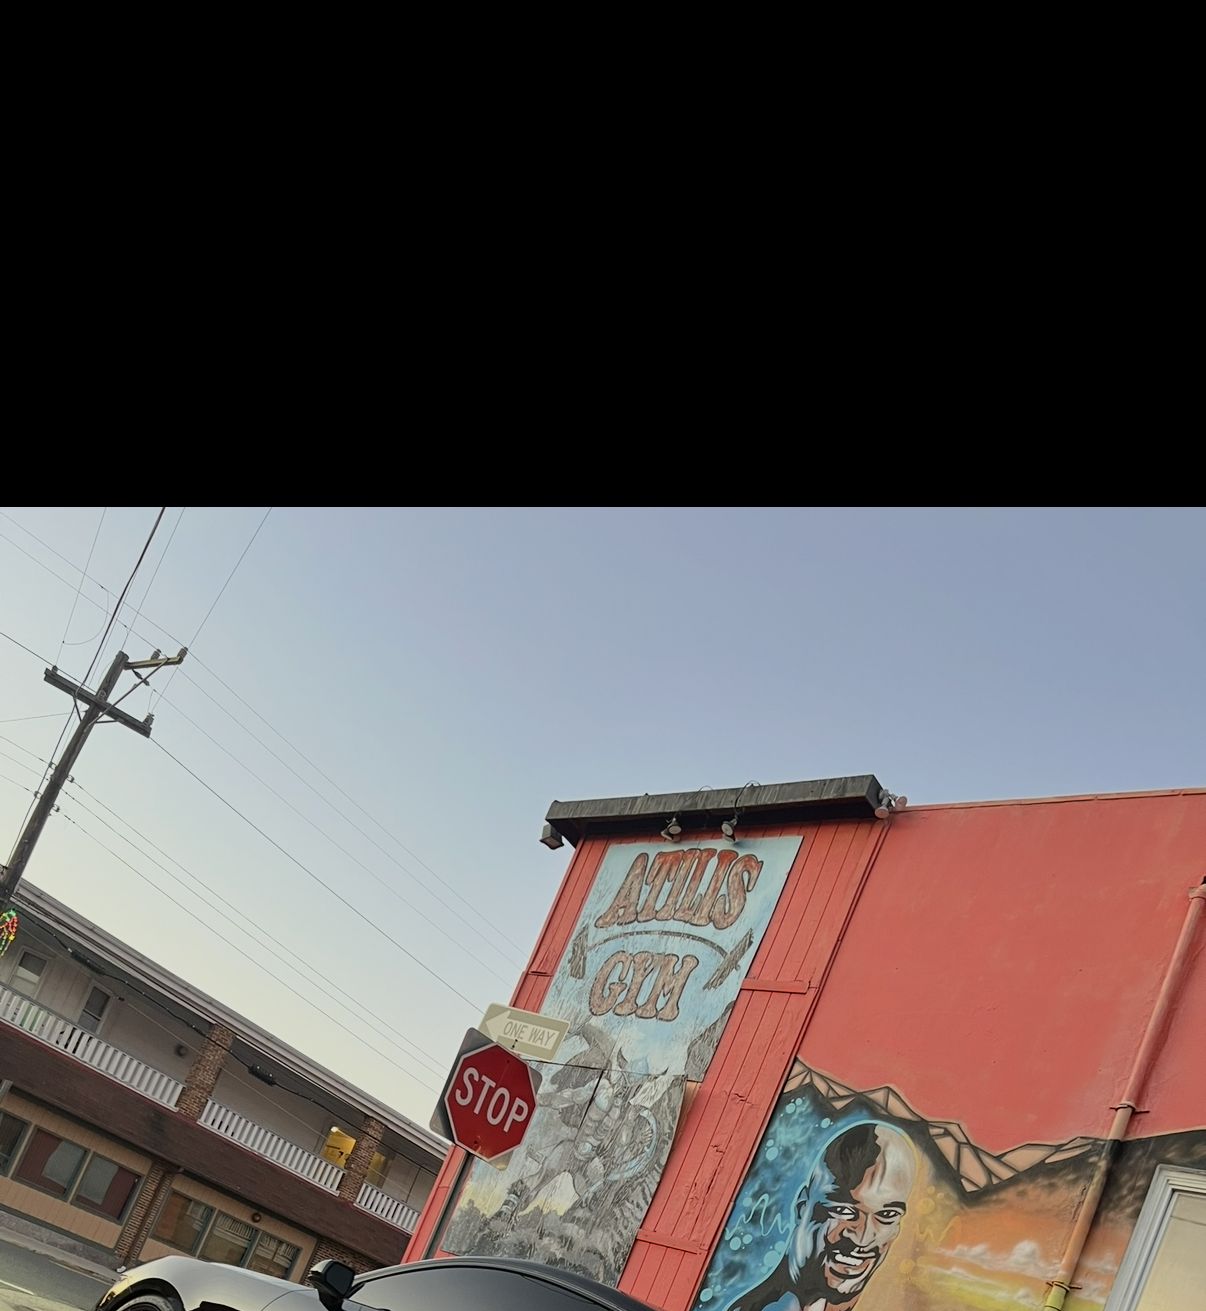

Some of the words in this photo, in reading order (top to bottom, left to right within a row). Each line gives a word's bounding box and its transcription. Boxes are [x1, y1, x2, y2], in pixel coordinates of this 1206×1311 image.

[595, 848, 764, 930] ATILIS
[589, 950, 699, 1022] GYM
[503, 1021, 528, 1040] ONE
[528, 1026, 557, 1047] WAY
[454, 1066, 530, 1133] STOP
